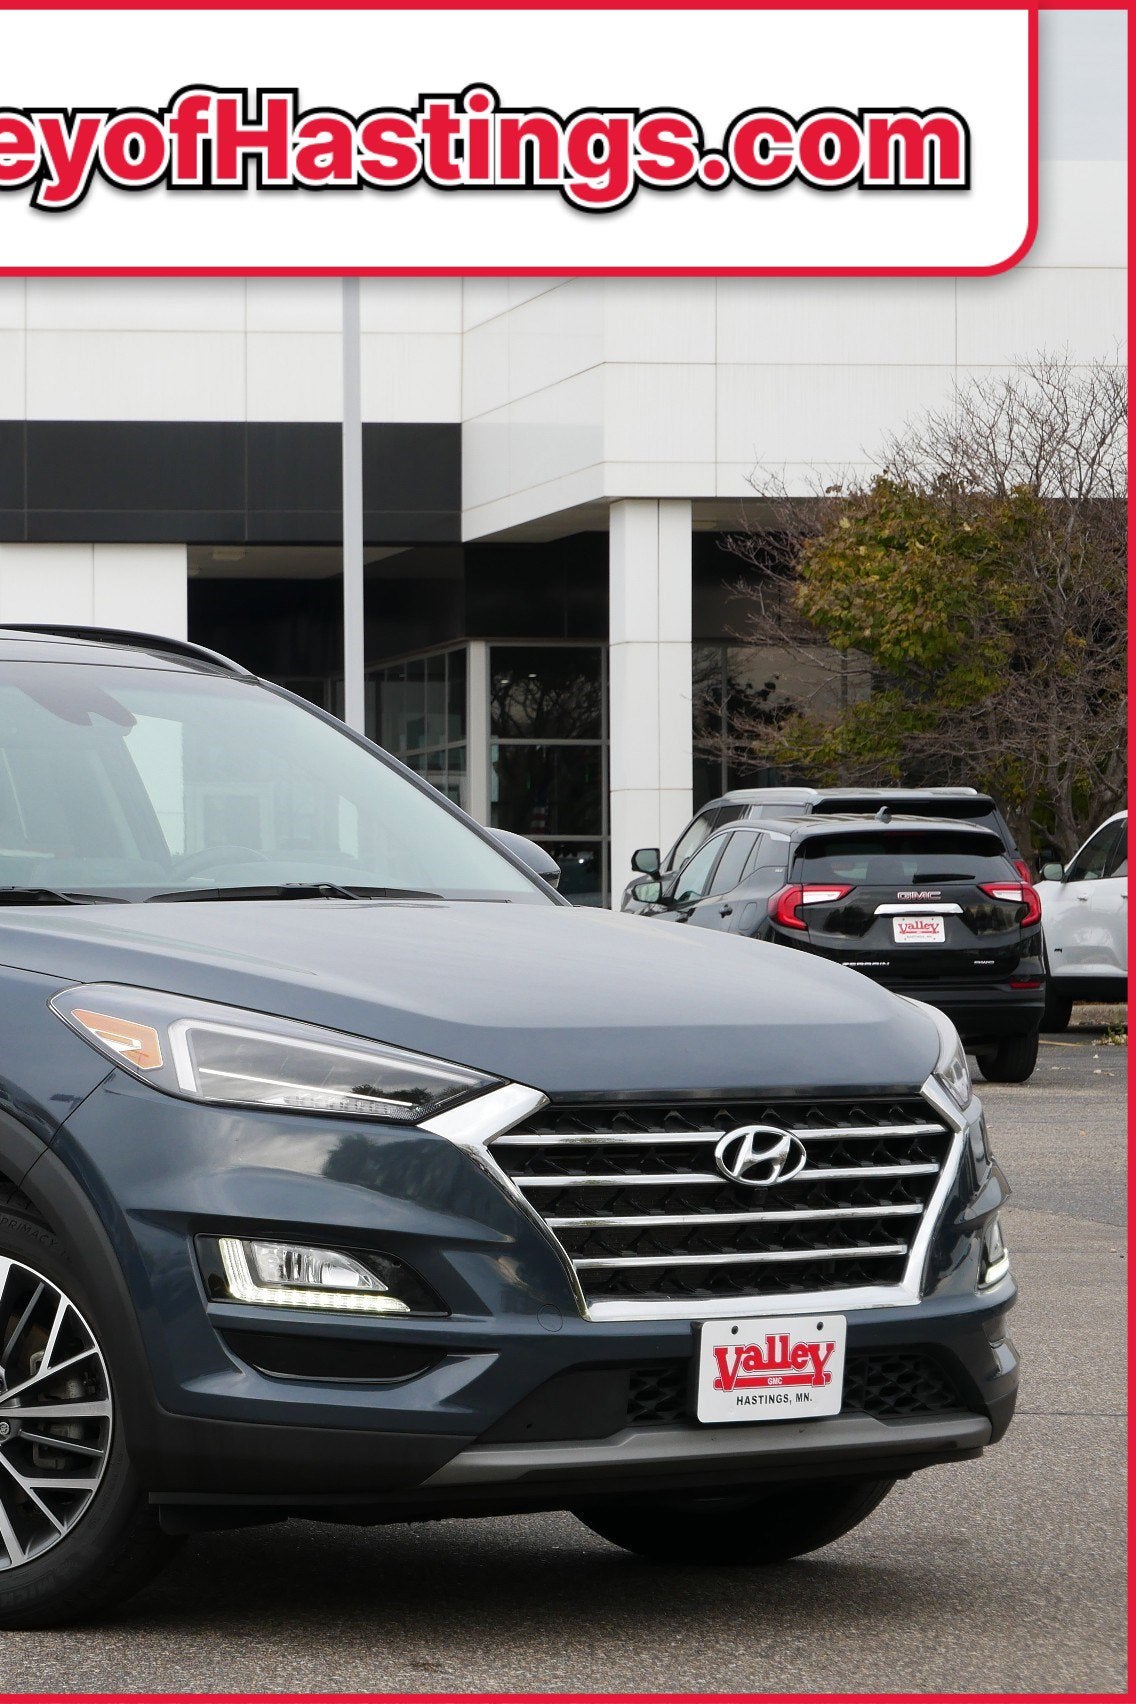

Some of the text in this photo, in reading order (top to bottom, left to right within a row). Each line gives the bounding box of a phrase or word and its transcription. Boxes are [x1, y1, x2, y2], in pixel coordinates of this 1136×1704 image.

[897, 891, 941, 900] GMC
[767, 1376, 783, 1386] GMC
[736, 1392, 813, 1406] HASTINGS, MN.
